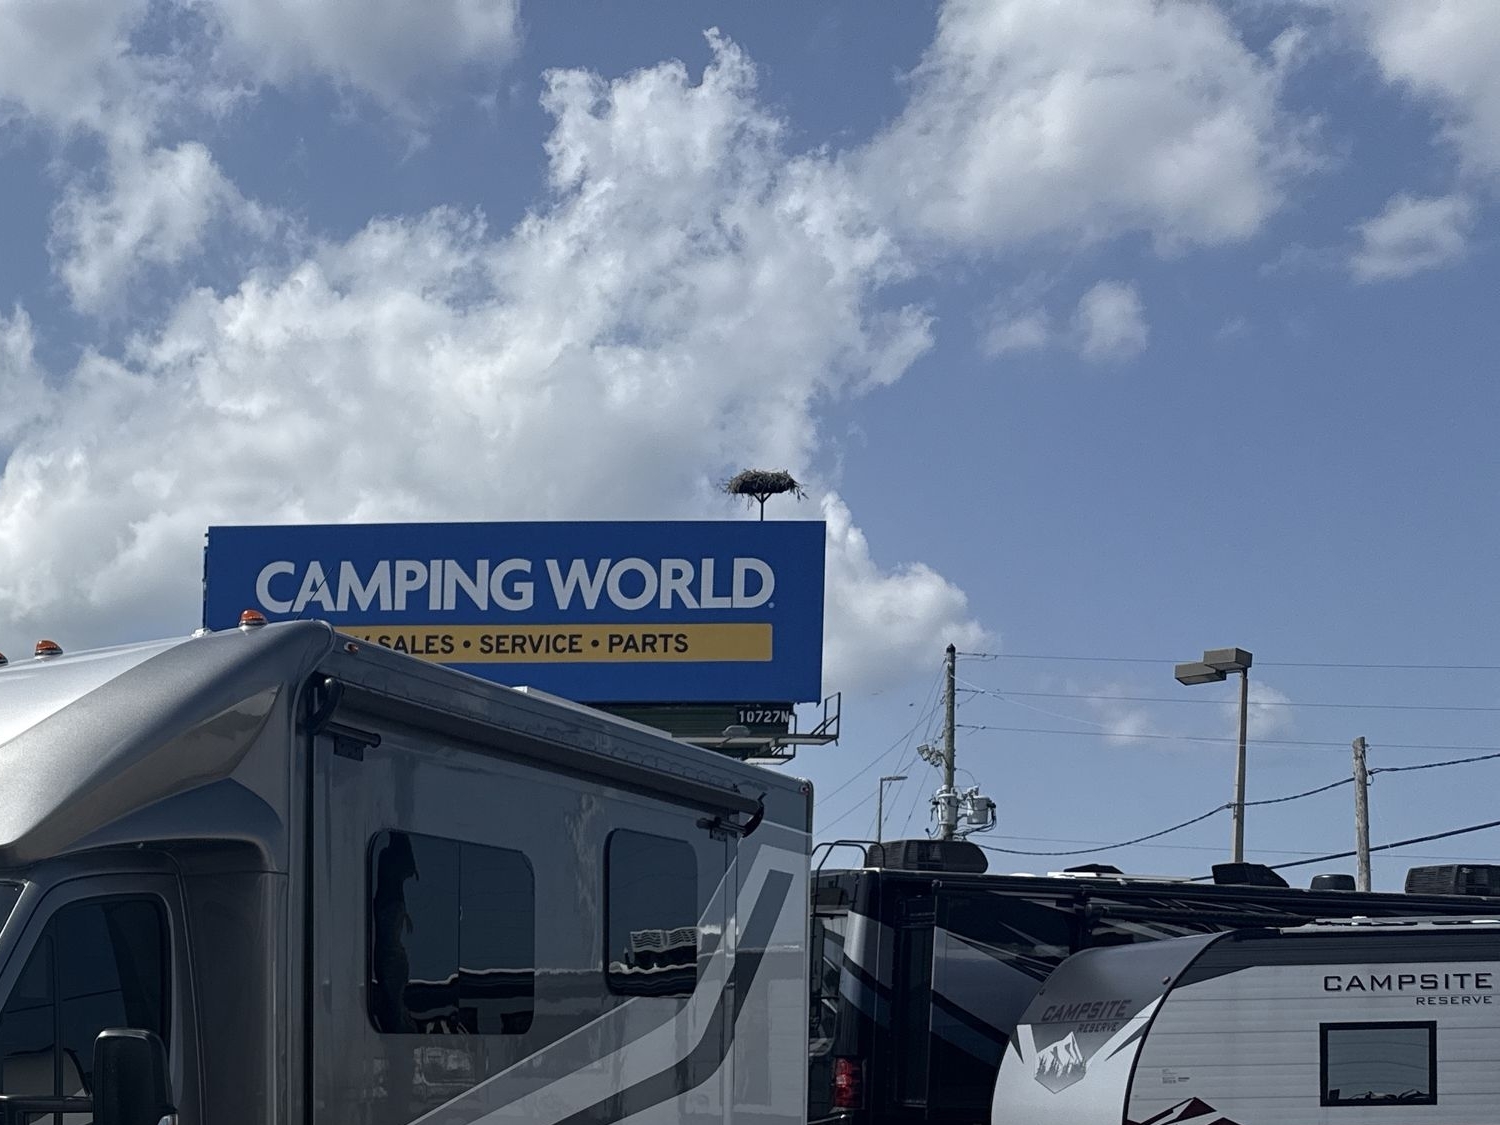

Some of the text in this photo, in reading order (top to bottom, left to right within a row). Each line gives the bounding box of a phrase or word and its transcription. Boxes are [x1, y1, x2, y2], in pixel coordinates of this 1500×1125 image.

[255, 557, 775, 614] CAMPING WORLD
[378, 633, 689, 654] SALES SERVICE PARTS
[739, 710, 790, 723] 10727N
[1323, 973, 1492, 992] CAMPSITE
[1416, 995, 1492, 1006] RESERVE
[1041, 999, 1132, 1022] CAMPSITE
[1077, 1021, 1119, 1033] RESERVE
